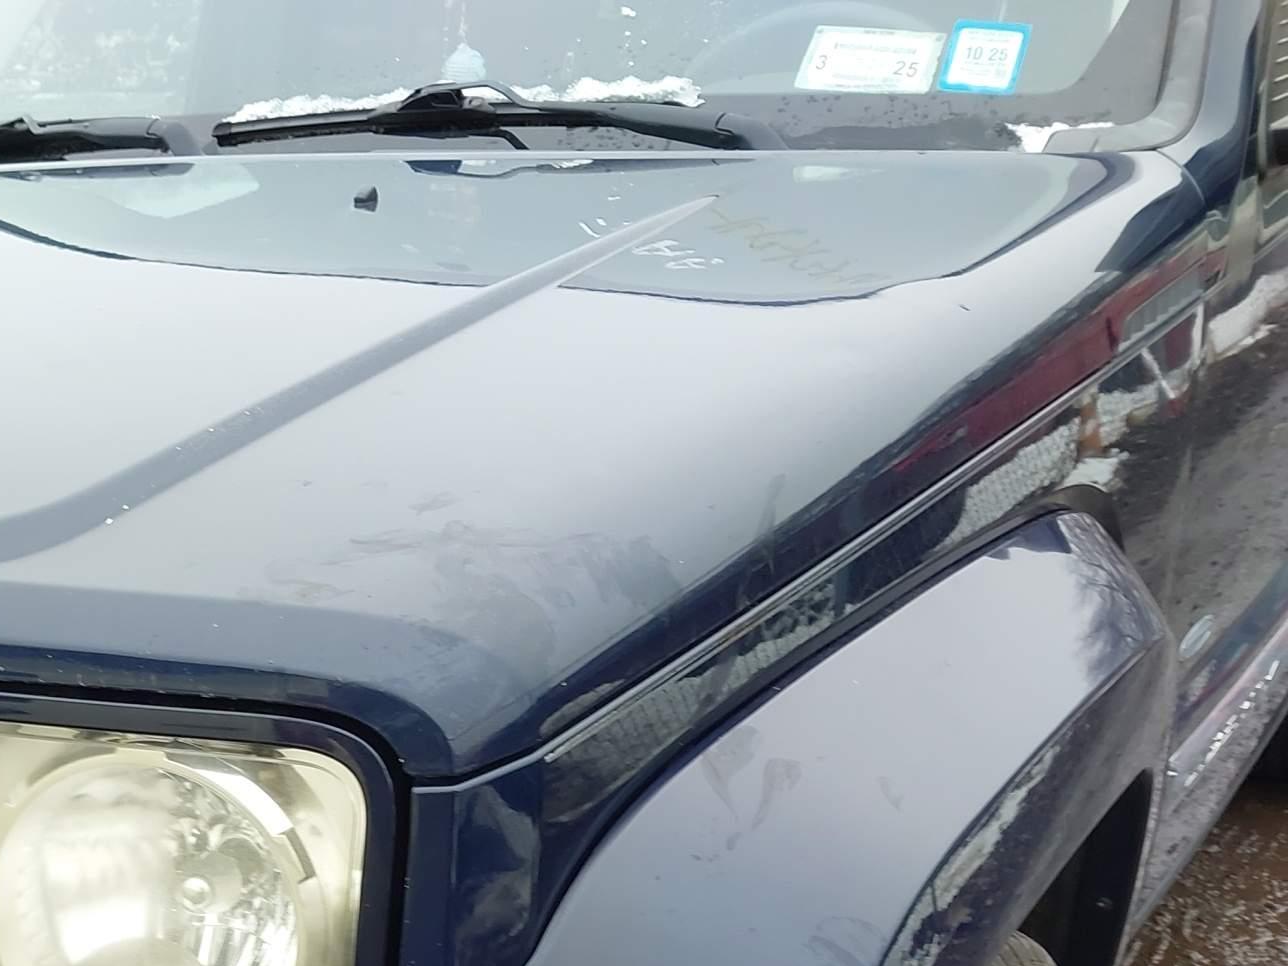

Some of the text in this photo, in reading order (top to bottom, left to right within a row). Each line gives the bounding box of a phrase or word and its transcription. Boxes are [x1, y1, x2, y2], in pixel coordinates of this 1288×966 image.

[965, 45, 1009, 61] 10 25
[815, 54, 920, 78] 3 25
